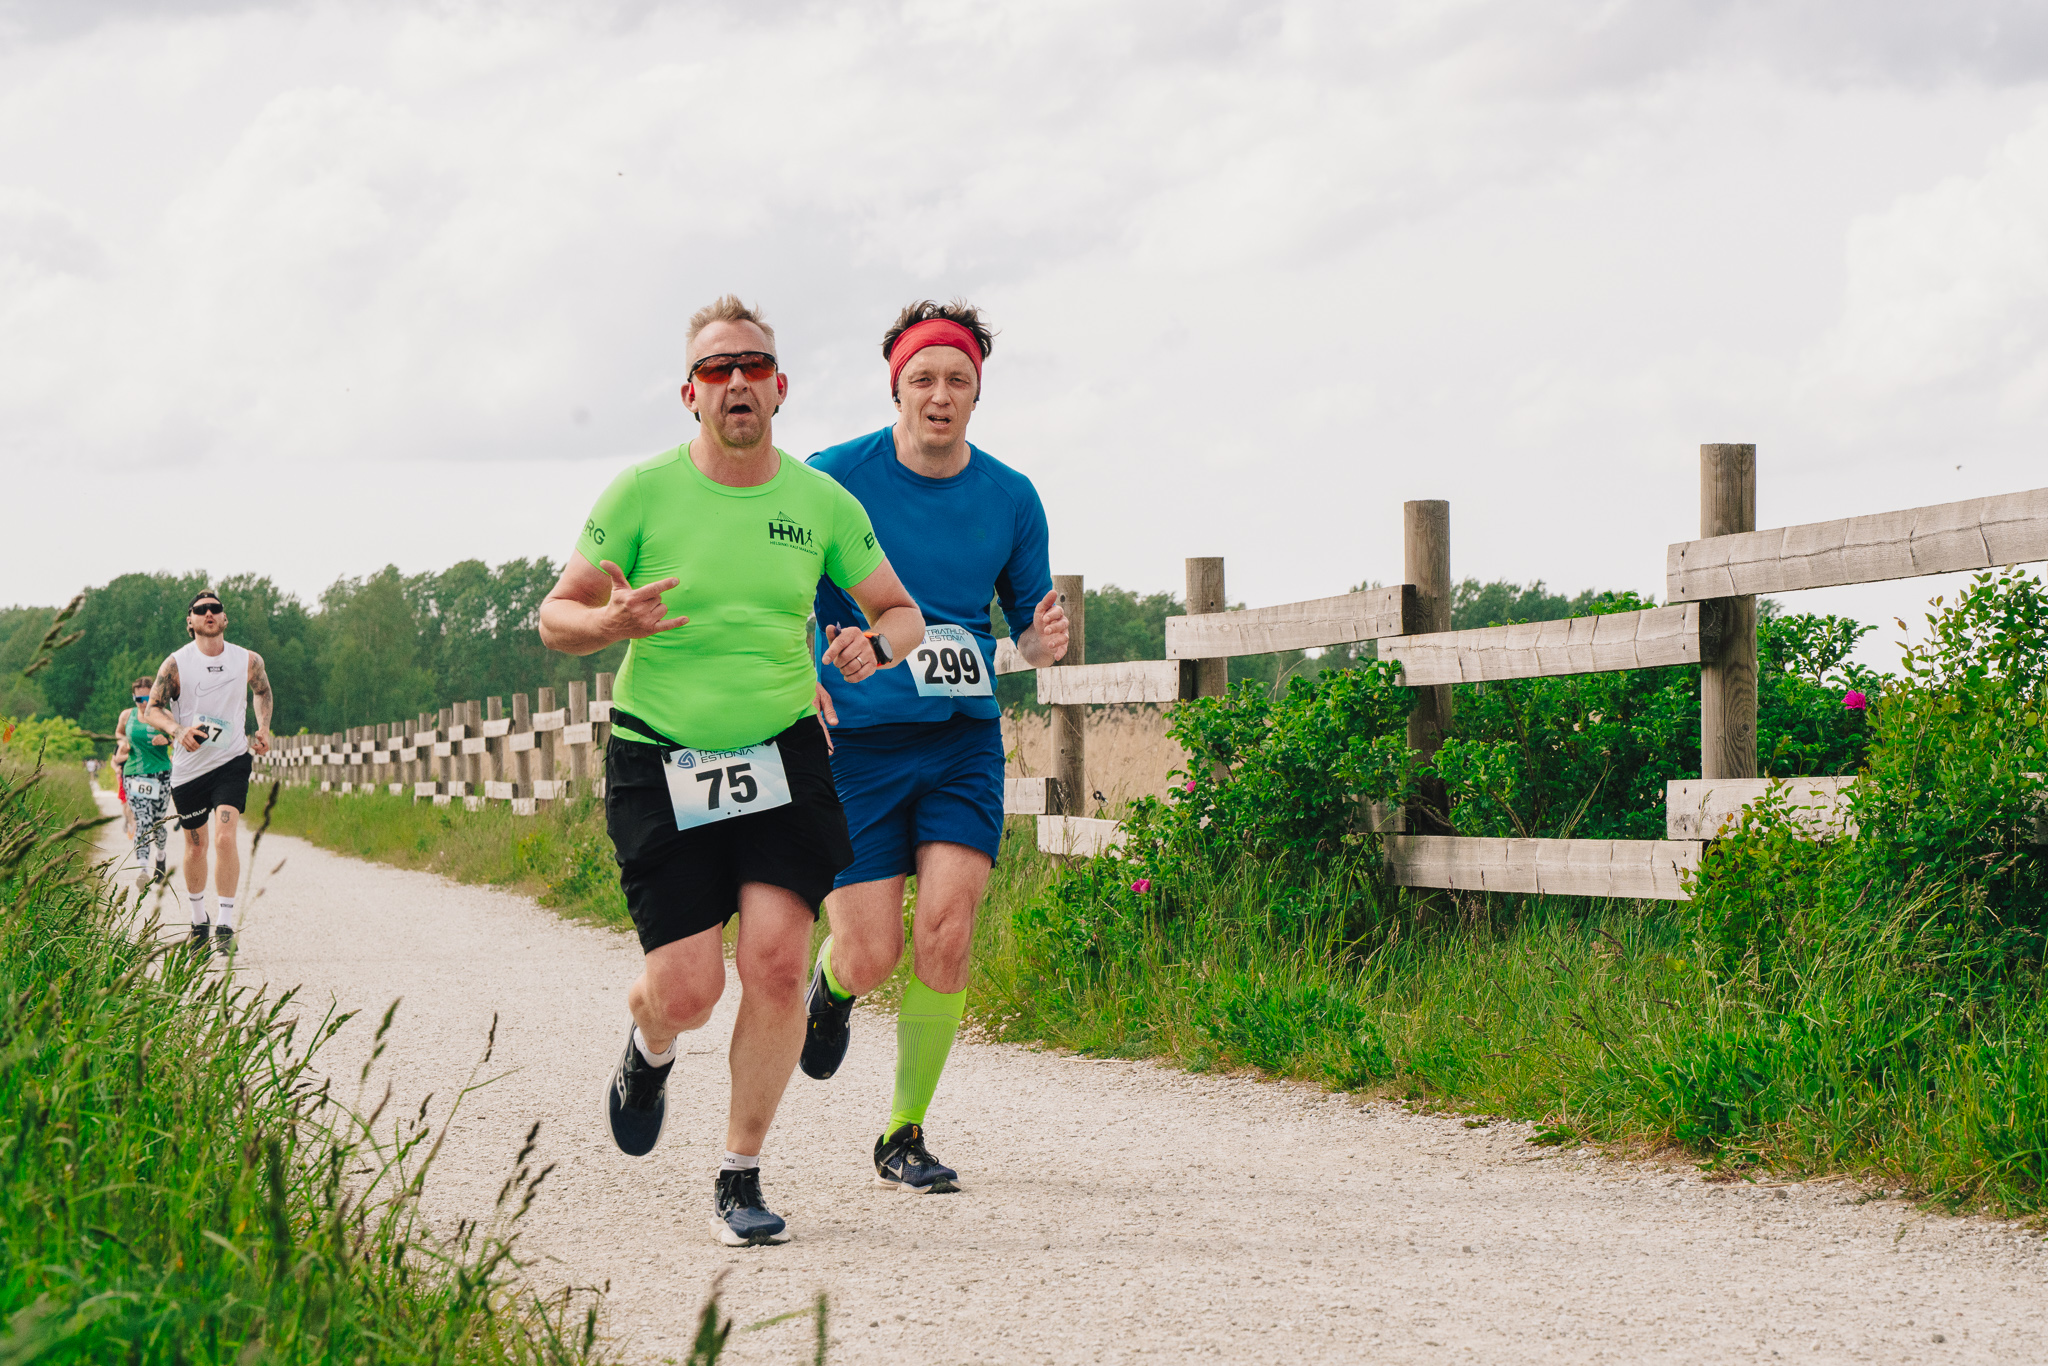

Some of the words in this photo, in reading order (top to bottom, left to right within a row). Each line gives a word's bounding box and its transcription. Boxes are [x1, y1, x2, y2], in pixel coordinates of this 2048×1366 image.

[929, 634, 966, 642] ESTONIA
[917, 647, 981, 685] 299
[700, 748, 755, 764] ESTONIA
[138, 783, 153, 795] 69
[695, 762, 758, 811] 75
